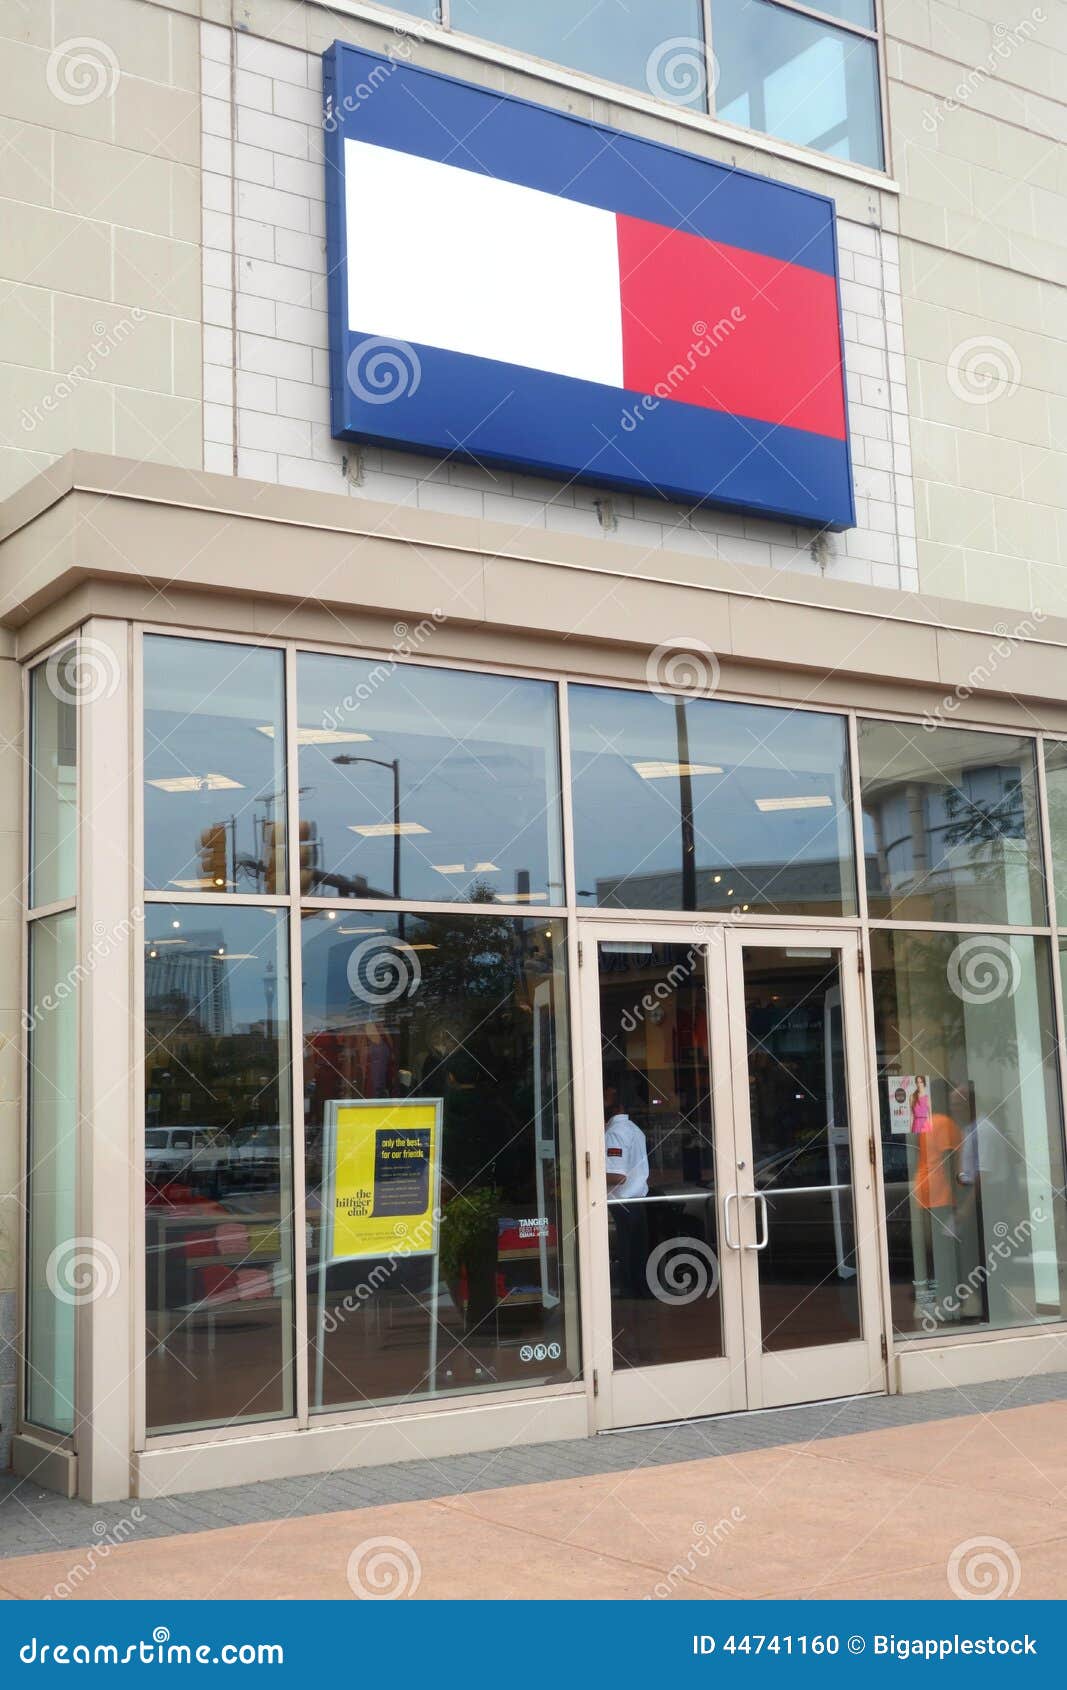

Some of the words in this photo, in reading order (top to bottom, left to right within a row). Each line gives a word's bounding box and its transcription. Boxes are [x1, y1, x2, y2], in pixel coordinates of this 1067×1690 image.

[382, 1137, 394, 1149] only
[396, 1137, 405, 1147] the
[382, 1150, 390, 1159] for
[391, 1151, 402, 1159] our
[403, 1149, 424, 1159] friends
[357, 1189, 371, 1199] the
[336, 1197, 371, 1208] hilfiger
[348, 1205, 368, 1217] club
[518, 1217, 549, 1228] TANGER
